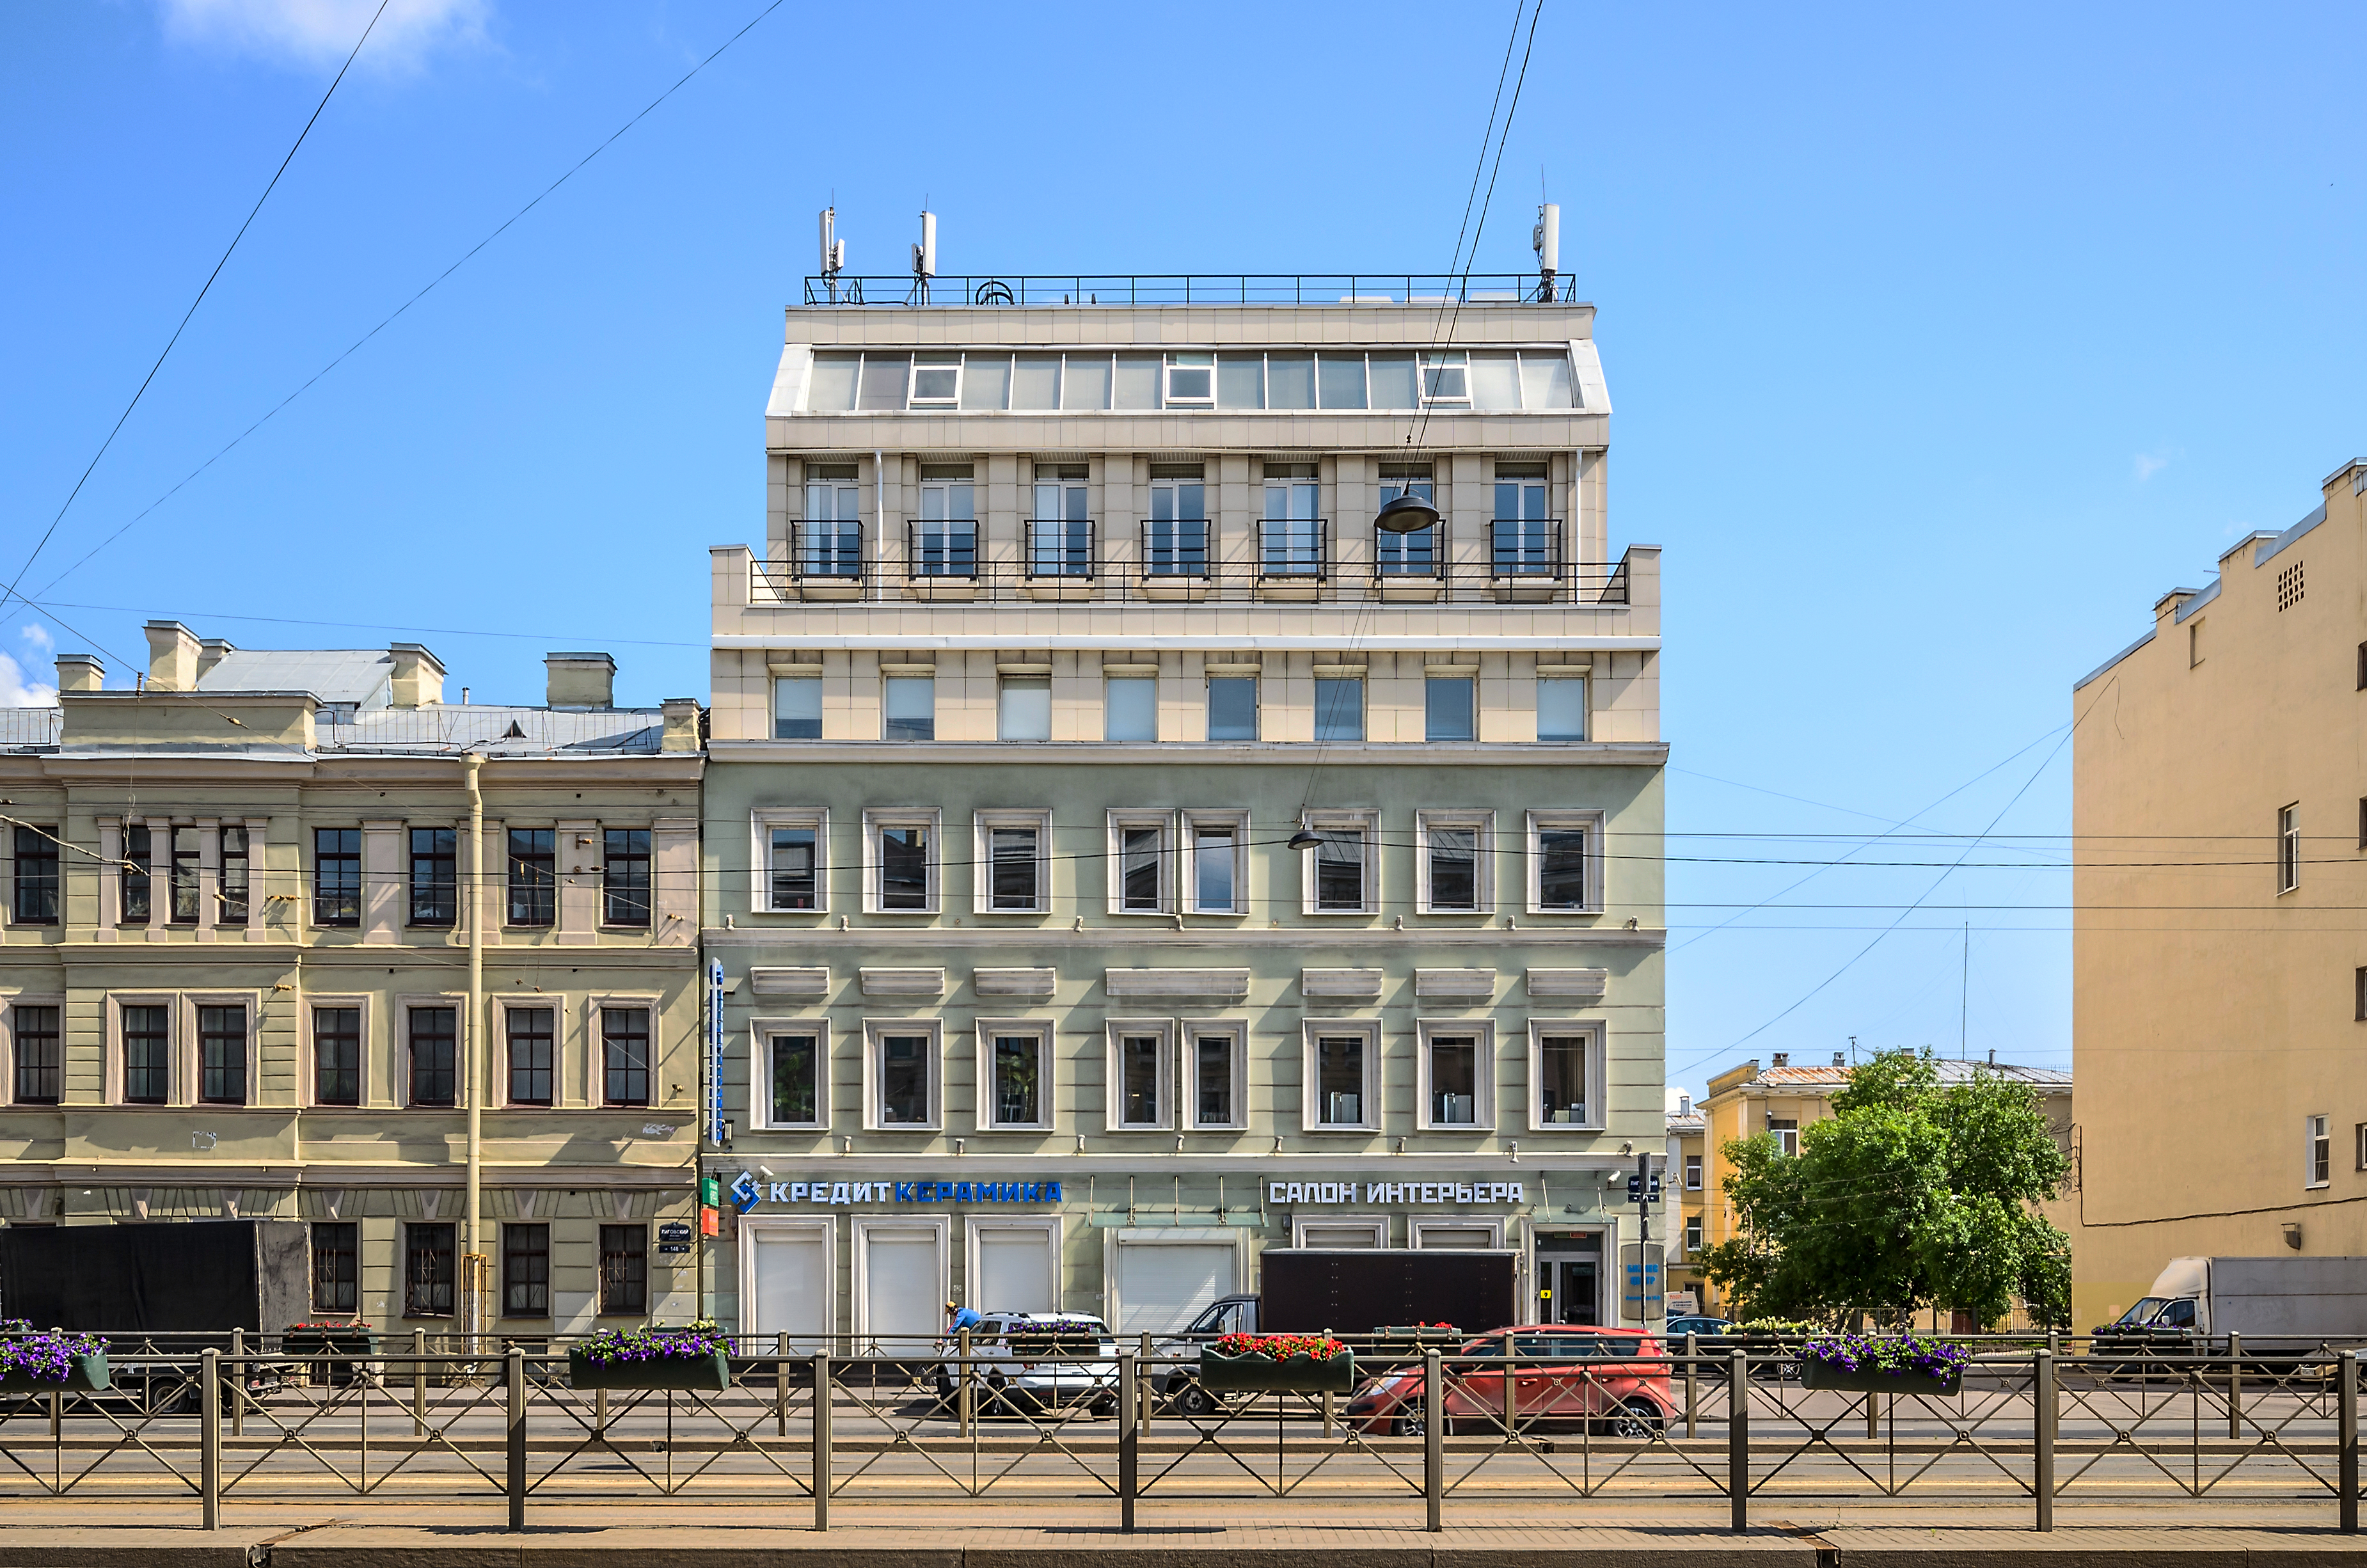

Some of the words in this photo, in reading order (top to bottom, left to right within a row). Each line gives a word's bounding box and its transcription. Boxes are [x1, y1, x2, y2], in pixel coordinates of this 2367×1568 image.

[770, 1182, 891, 1205] КРЕДИТ
[895, 1182, 1063, 1203] КЕРАМИКА
[1270, 1182, 1356, 1203] САЛОН
[1366, 1182, 1524, 1204] ИНТЕРЬЕРА
